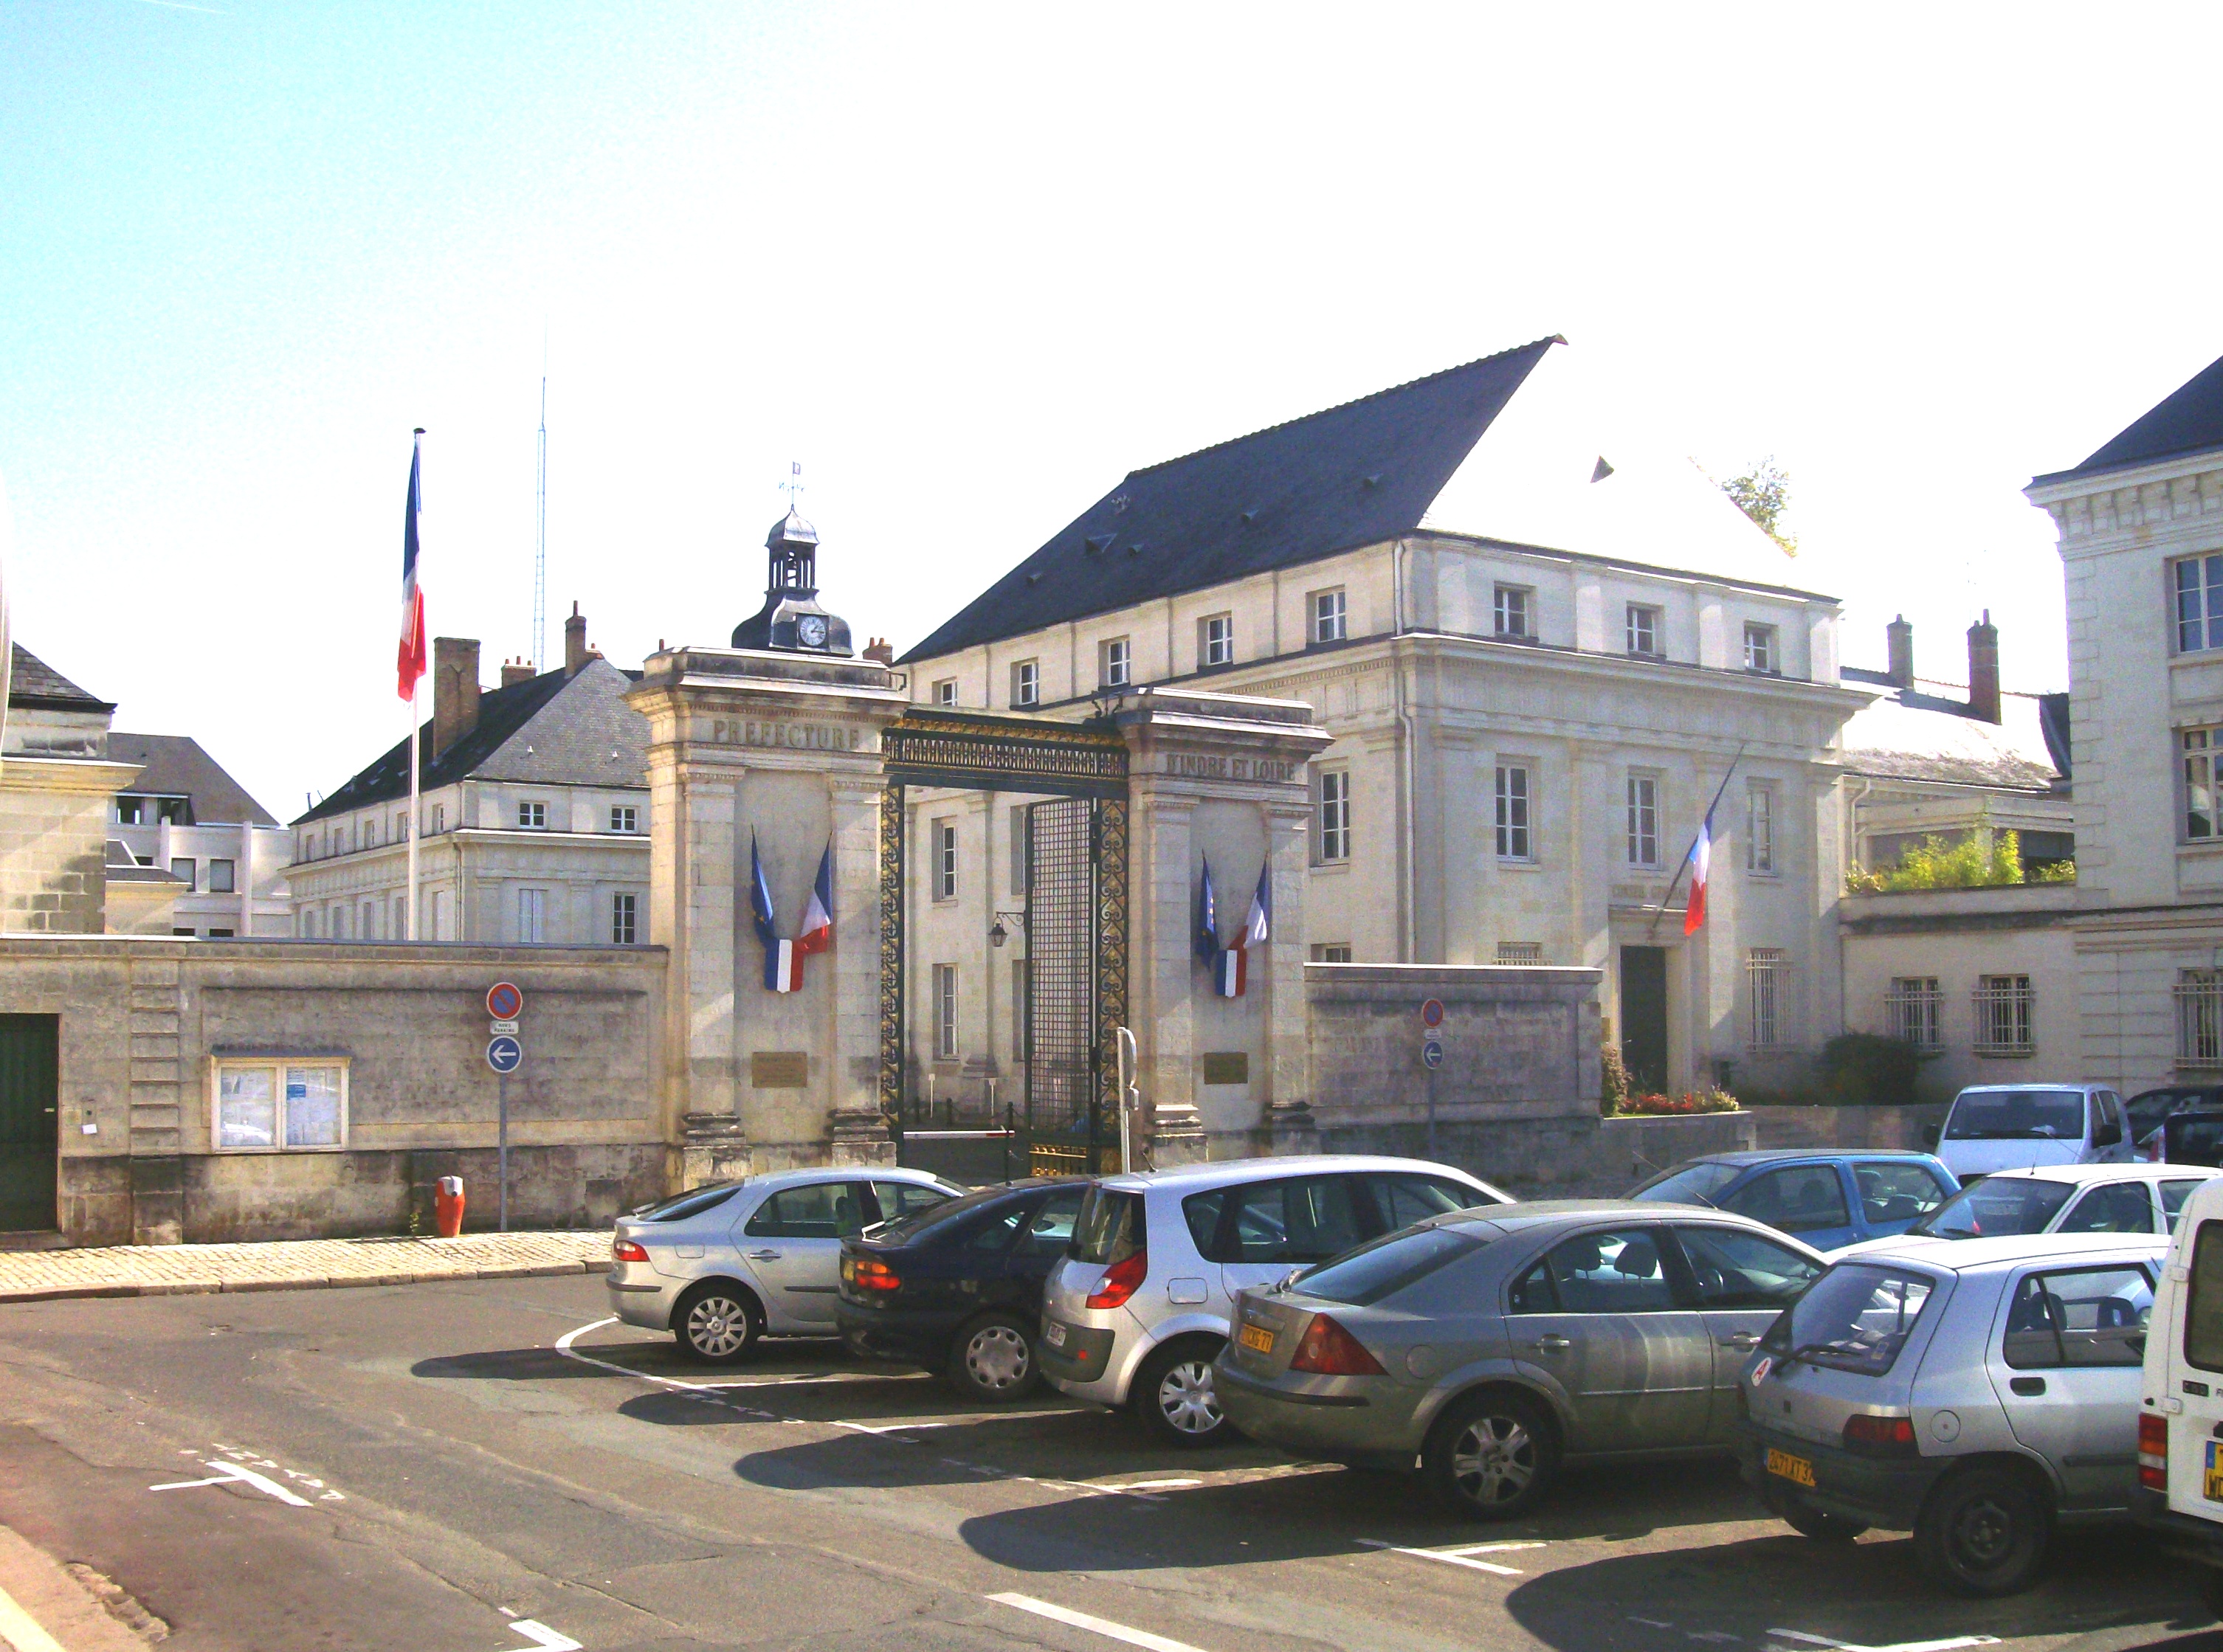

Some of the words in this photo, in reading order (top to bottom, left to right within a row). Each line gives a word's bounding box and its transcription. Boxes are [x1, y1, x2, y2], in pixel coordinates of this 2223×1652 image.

[713, 719, 860, 750] PREFECTURE
[1167, 754, 1227, 776] D'INDRE
[1233, 758, 1249, 779] ET
[1253, 761, 1296, 781] LOIRE
